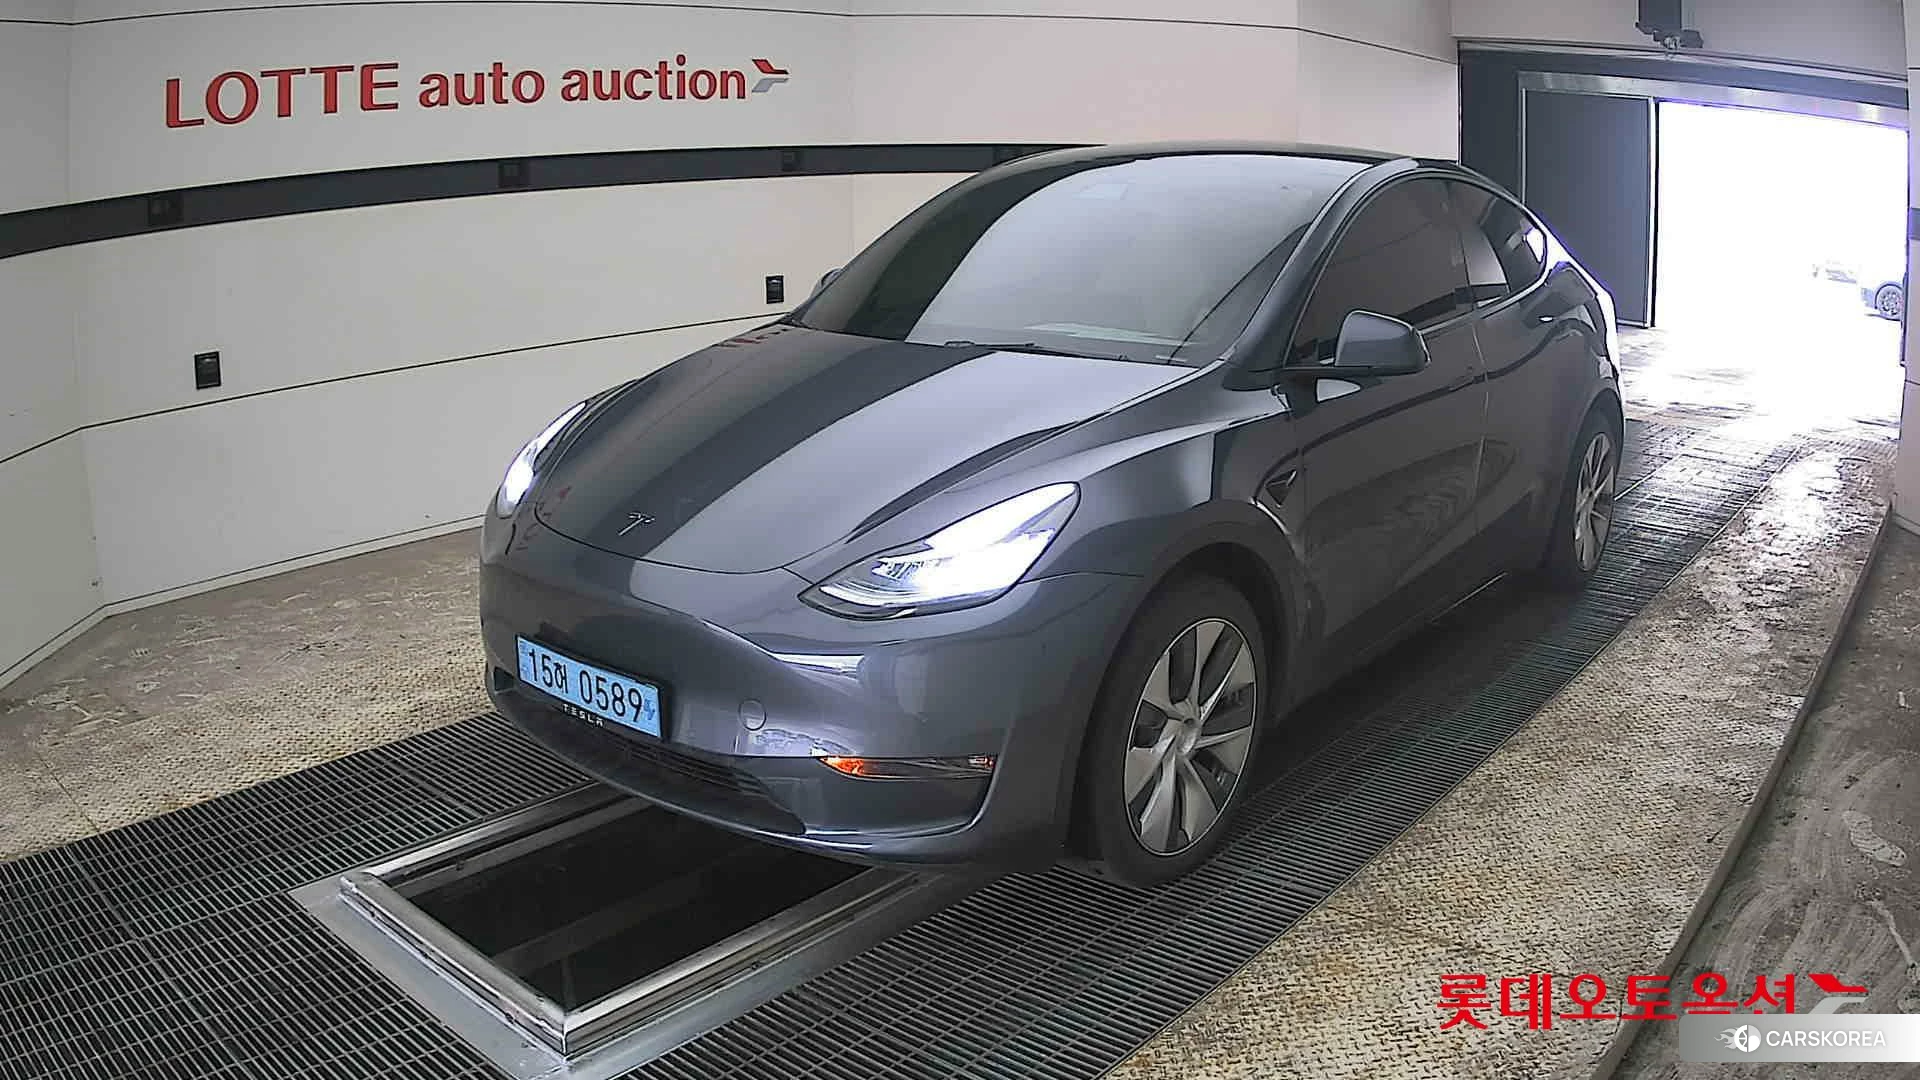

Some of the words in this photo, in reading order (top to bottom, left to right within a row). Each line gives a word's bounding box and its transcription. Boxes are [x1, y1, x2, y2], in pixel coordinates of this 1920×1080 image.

[166, 63, 399, 128] LOTTE
[418, 62, 544, 108] auto
[561, 54, 747, 102] auction
[528, 649, 568, 694] 15허
[579, 670, 642, 722] 0589
[562, 703, 604, 727] TESLA
